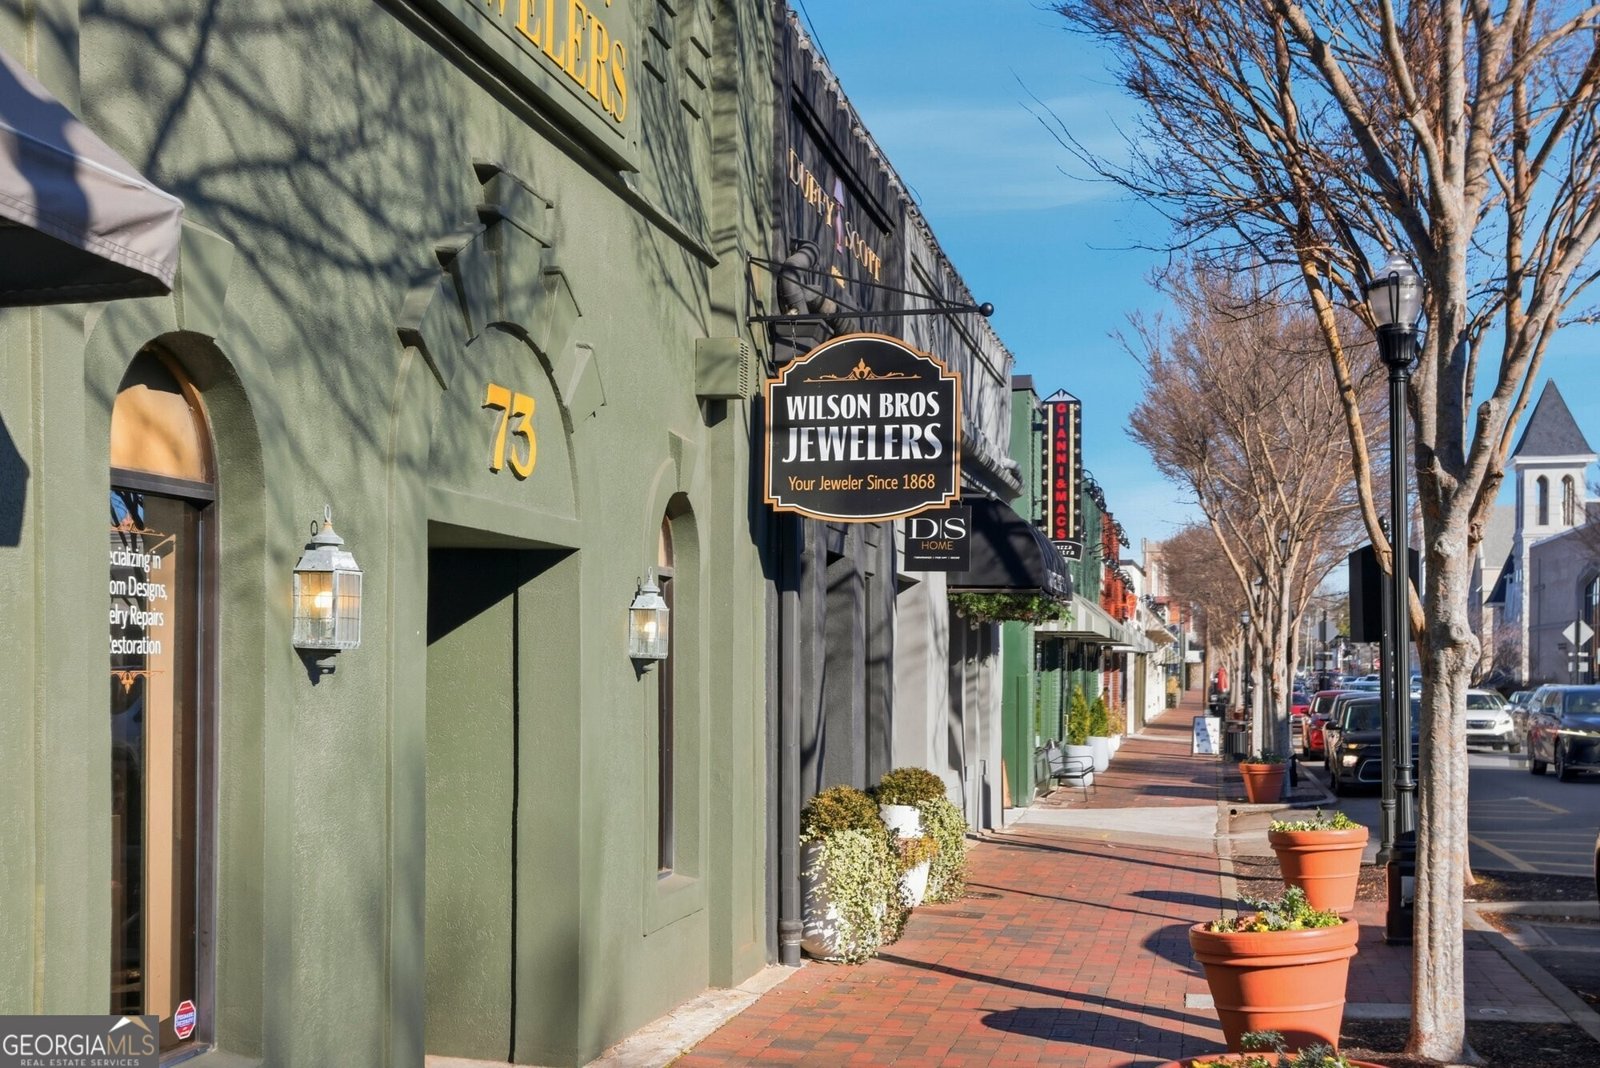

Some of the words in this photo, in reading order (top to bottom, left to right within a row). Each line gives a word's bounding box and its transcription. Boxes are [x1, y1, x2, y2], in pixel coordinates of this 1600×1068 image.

[486, 0, 627, 123] ELERS
[789, 148, 834, 228] DUFFY
[845, 221, 881, 282] SCOTT
[786, 394, 871, 420] WILSON
[879, 391, 940, 418] BROS
[482, 383, 537, 481] 73
[782, 423, 943, 463] JEWELERS
[788, 477, 816, 491] Your
[819, 475, 864, 491] Jeweler
[867, 474, 899, 489] Since
[902, 473, 935, 489] 1868
[152, 551, 161, 569] in
[921, 541, 953, 551] HOME
[128, 576, 168, 601] Designs,
[130, 605, 164, 630] Repairs
